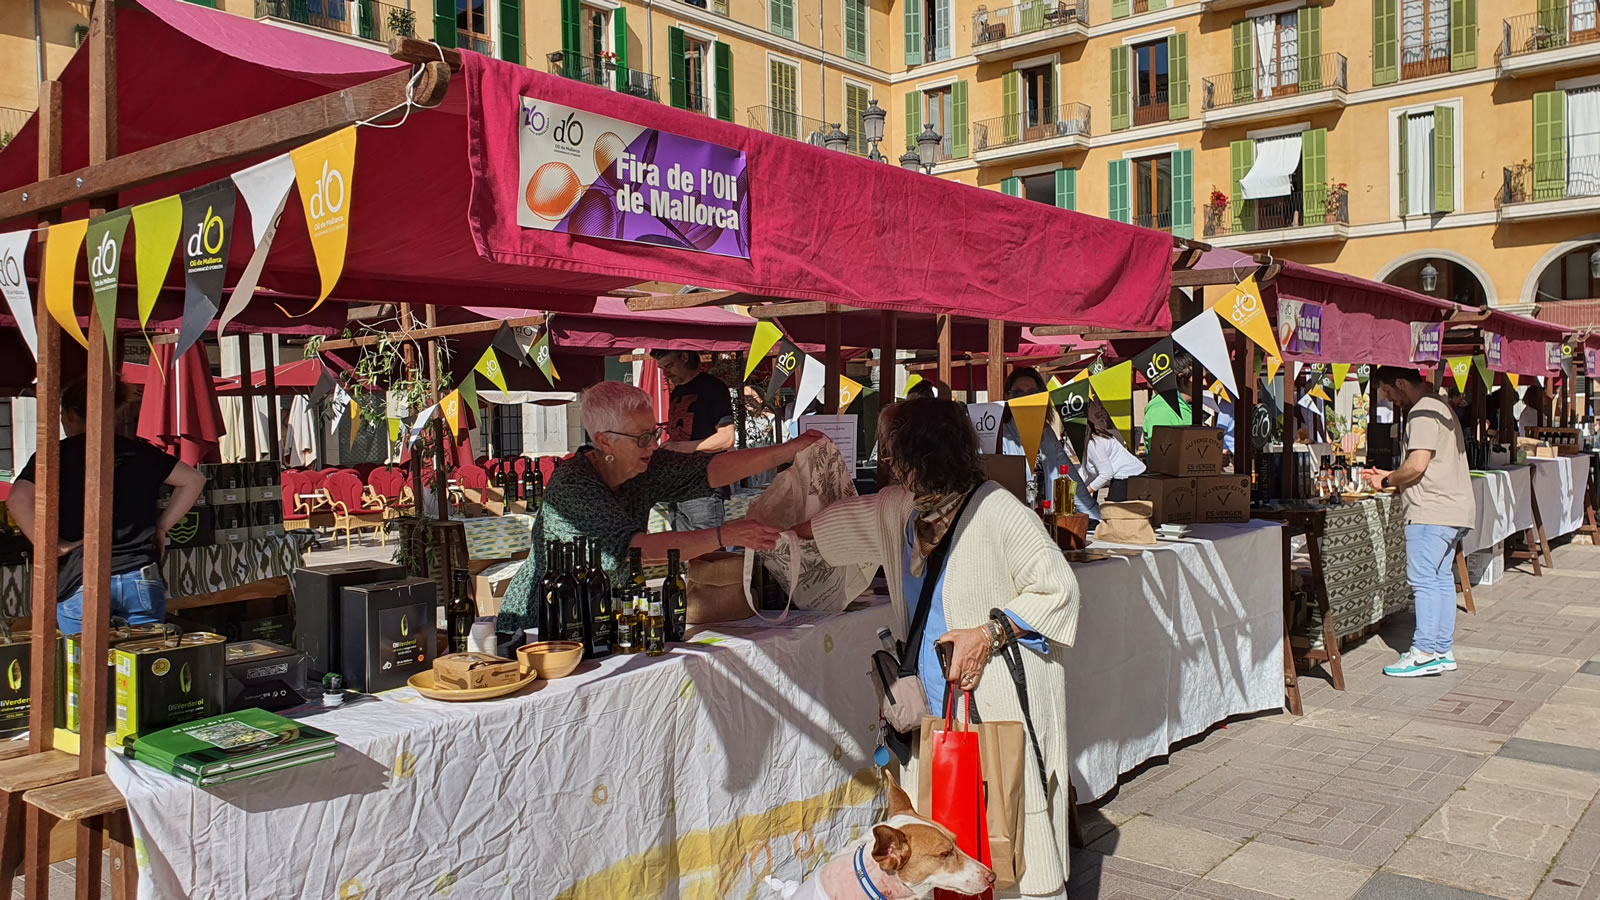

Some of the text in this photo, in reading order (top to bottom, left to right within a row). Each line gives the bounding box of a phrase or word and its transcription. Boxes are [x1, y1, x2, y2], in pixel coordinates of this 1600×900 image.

[617, 151, 660, 186] Fira
[667, 163, 694, 192] de
[616, 184, 739, 230] de Mallorca
